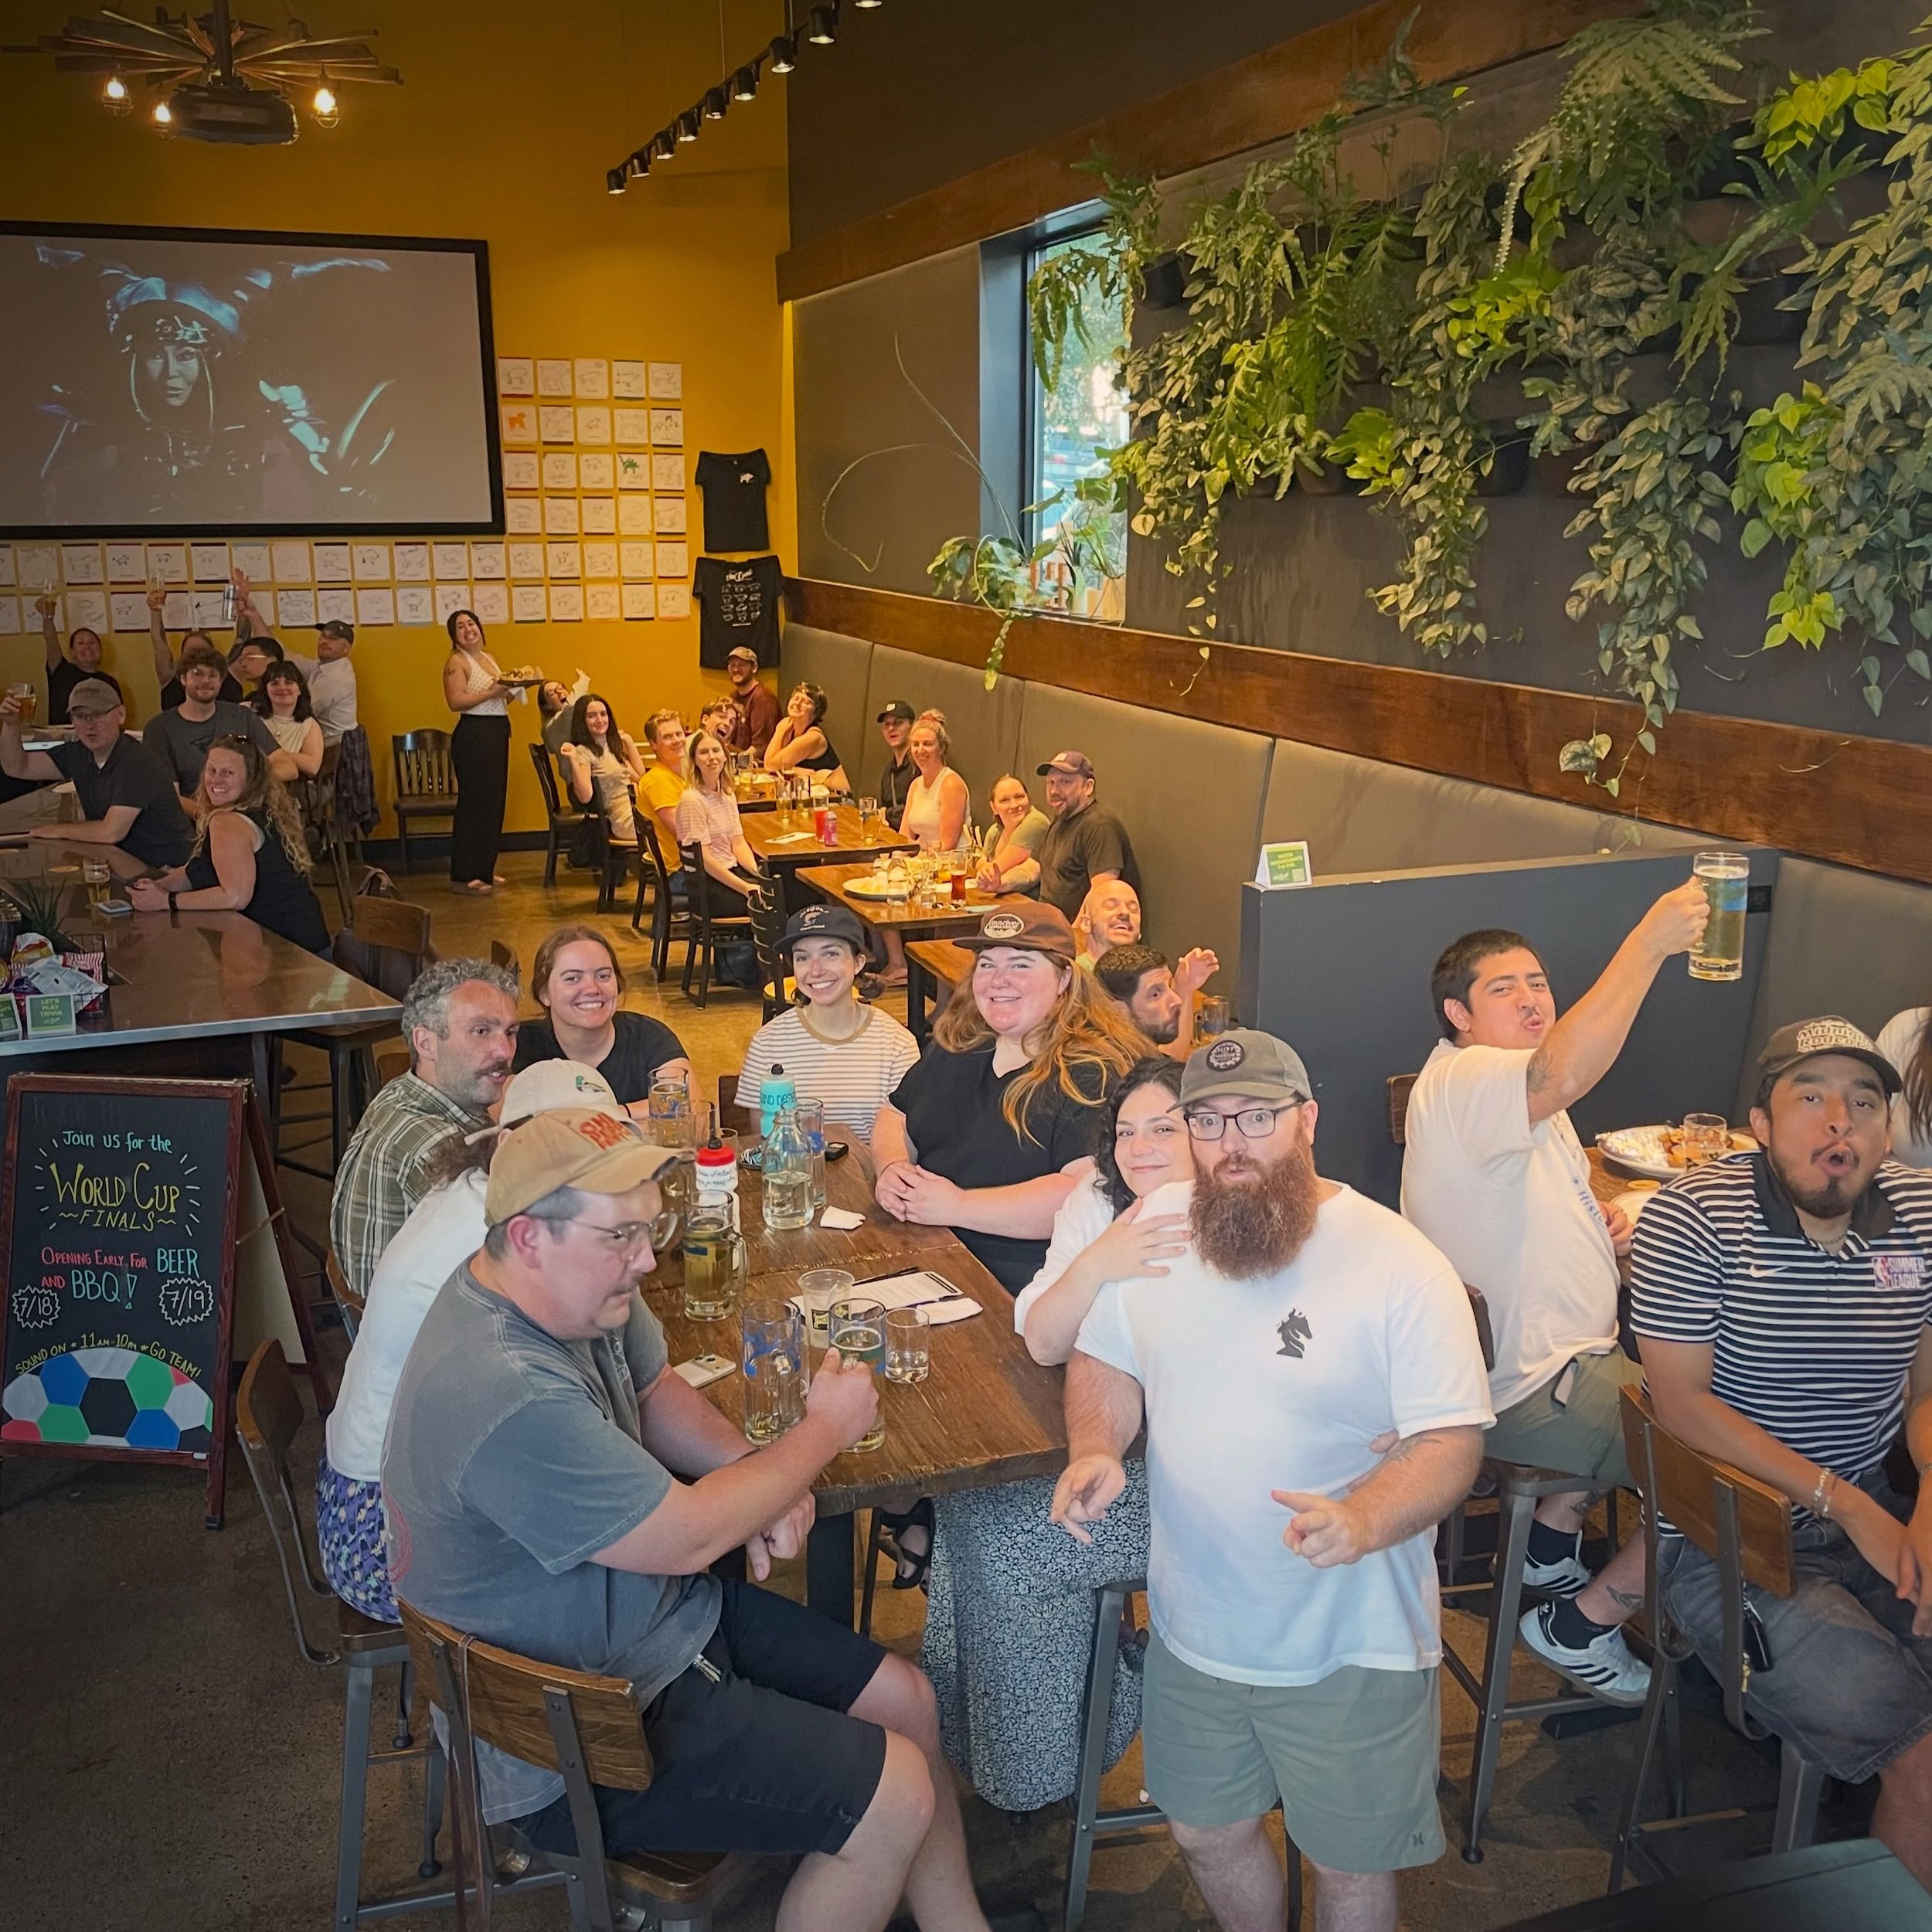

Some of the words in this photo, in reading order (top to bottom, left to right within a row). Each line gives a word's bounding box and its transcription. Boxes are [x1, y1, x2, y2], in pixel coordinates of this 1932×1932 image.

[63, 1131, 94, 1148] Join
[103, 1134, 120, 1148] us
[125, 1131, 145, 1153] for
[148, 1134, 173, 1154] the
[49, 1162, 126, 1207] WORLD
[134, 1162, 180, 1213] CUP
[41, 1247, 92, 1265] OPENING
[94, 1249, 124, 1267] EARLY
[130, 1252, 148, 1269] FOR
[157, 1247, 200, 1279] BEER
[1887, 1257, 1926, 1273] SUMMER
[42, 1275, 66, 1289] AND
[1889, 1273, 1921, 1289] LEAGUE
[18, 1295, 53, 1318] 7/18
[166, 1286, 206, 1316] 7/19
[15, 1349, 48, 1375] SOUND
[50, 1342, 66, 1357] ON
[149, 1340, 166, 1360] GO
[169, 1351, 202, 1378] TEAM!
